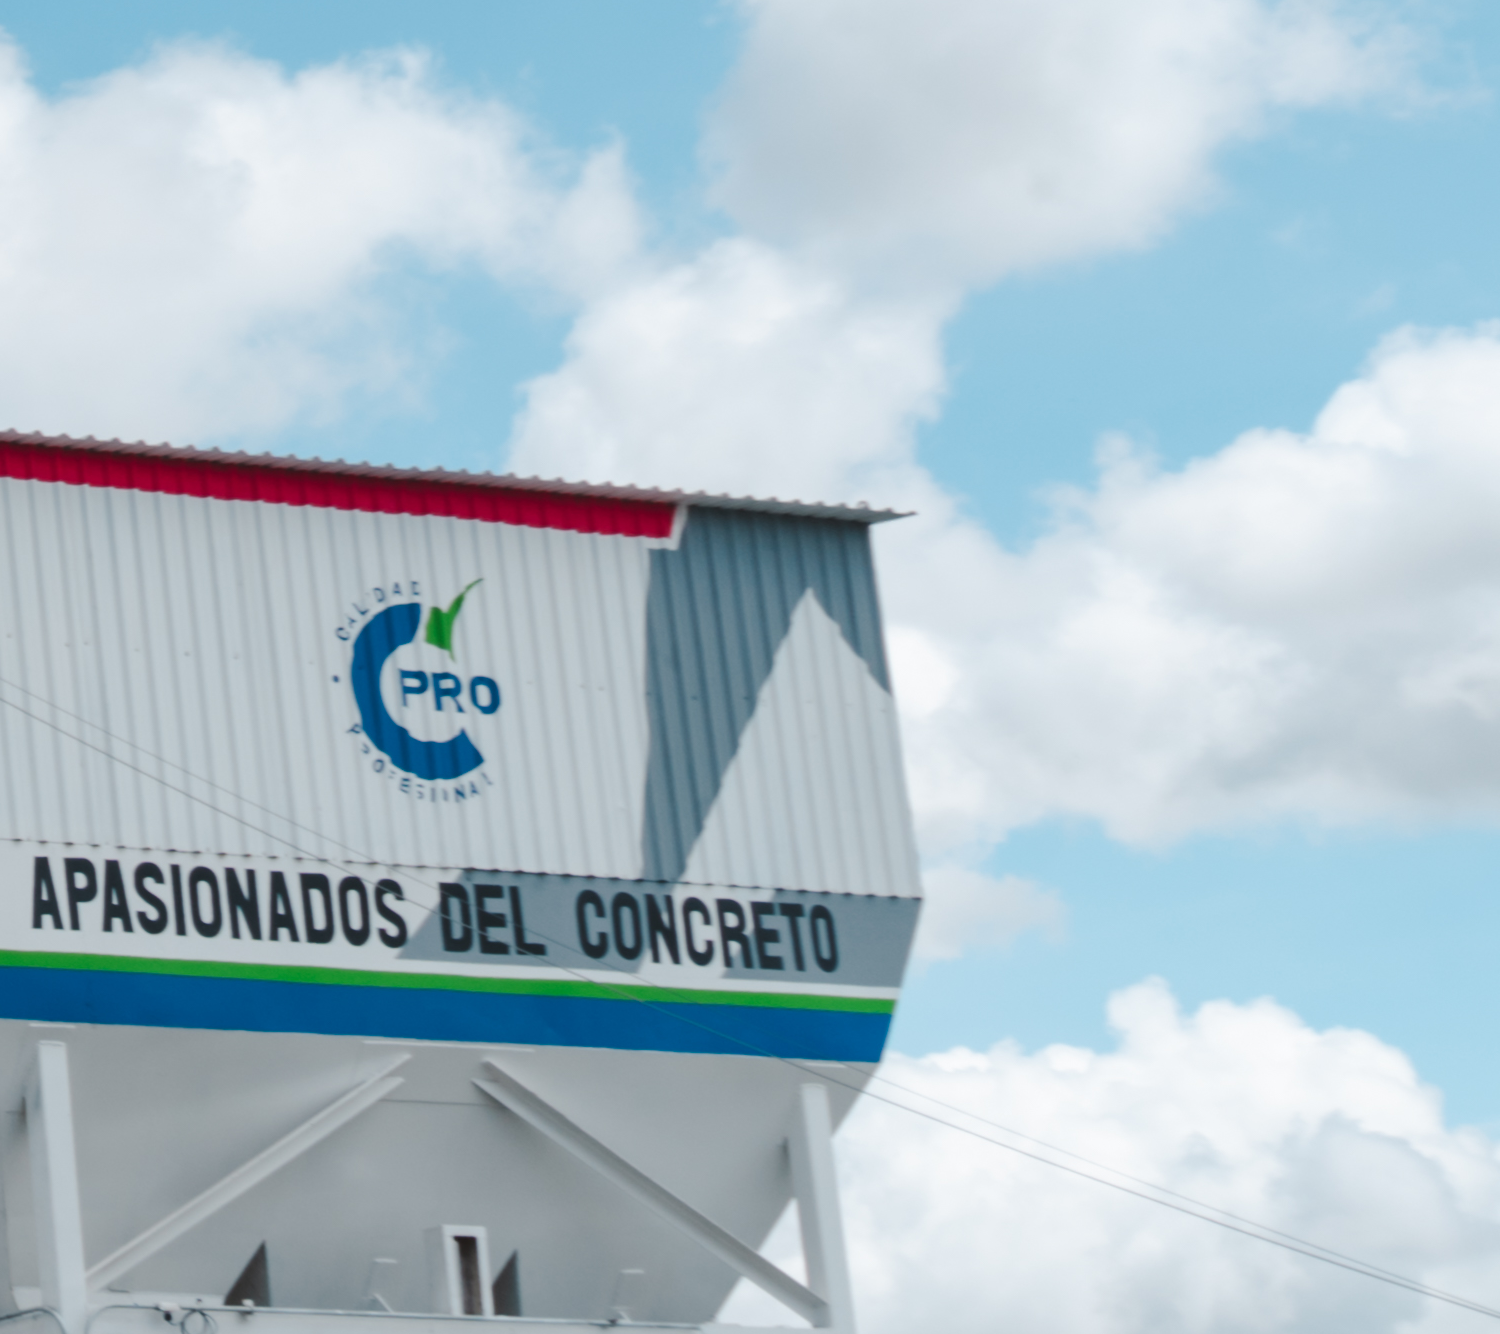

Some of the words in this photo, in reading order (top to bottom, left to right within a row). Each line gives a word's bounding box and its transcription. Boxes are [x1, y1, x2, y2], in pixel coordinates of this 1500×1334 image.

[334, 580, 422, 642] CALDA
[399, 667, 502, 716] PRO
[31, 856, 409, 950] APASIONADOS
[437, 881, 549, 957] DEL
[575, 888, 840, 974] CONCRETO
